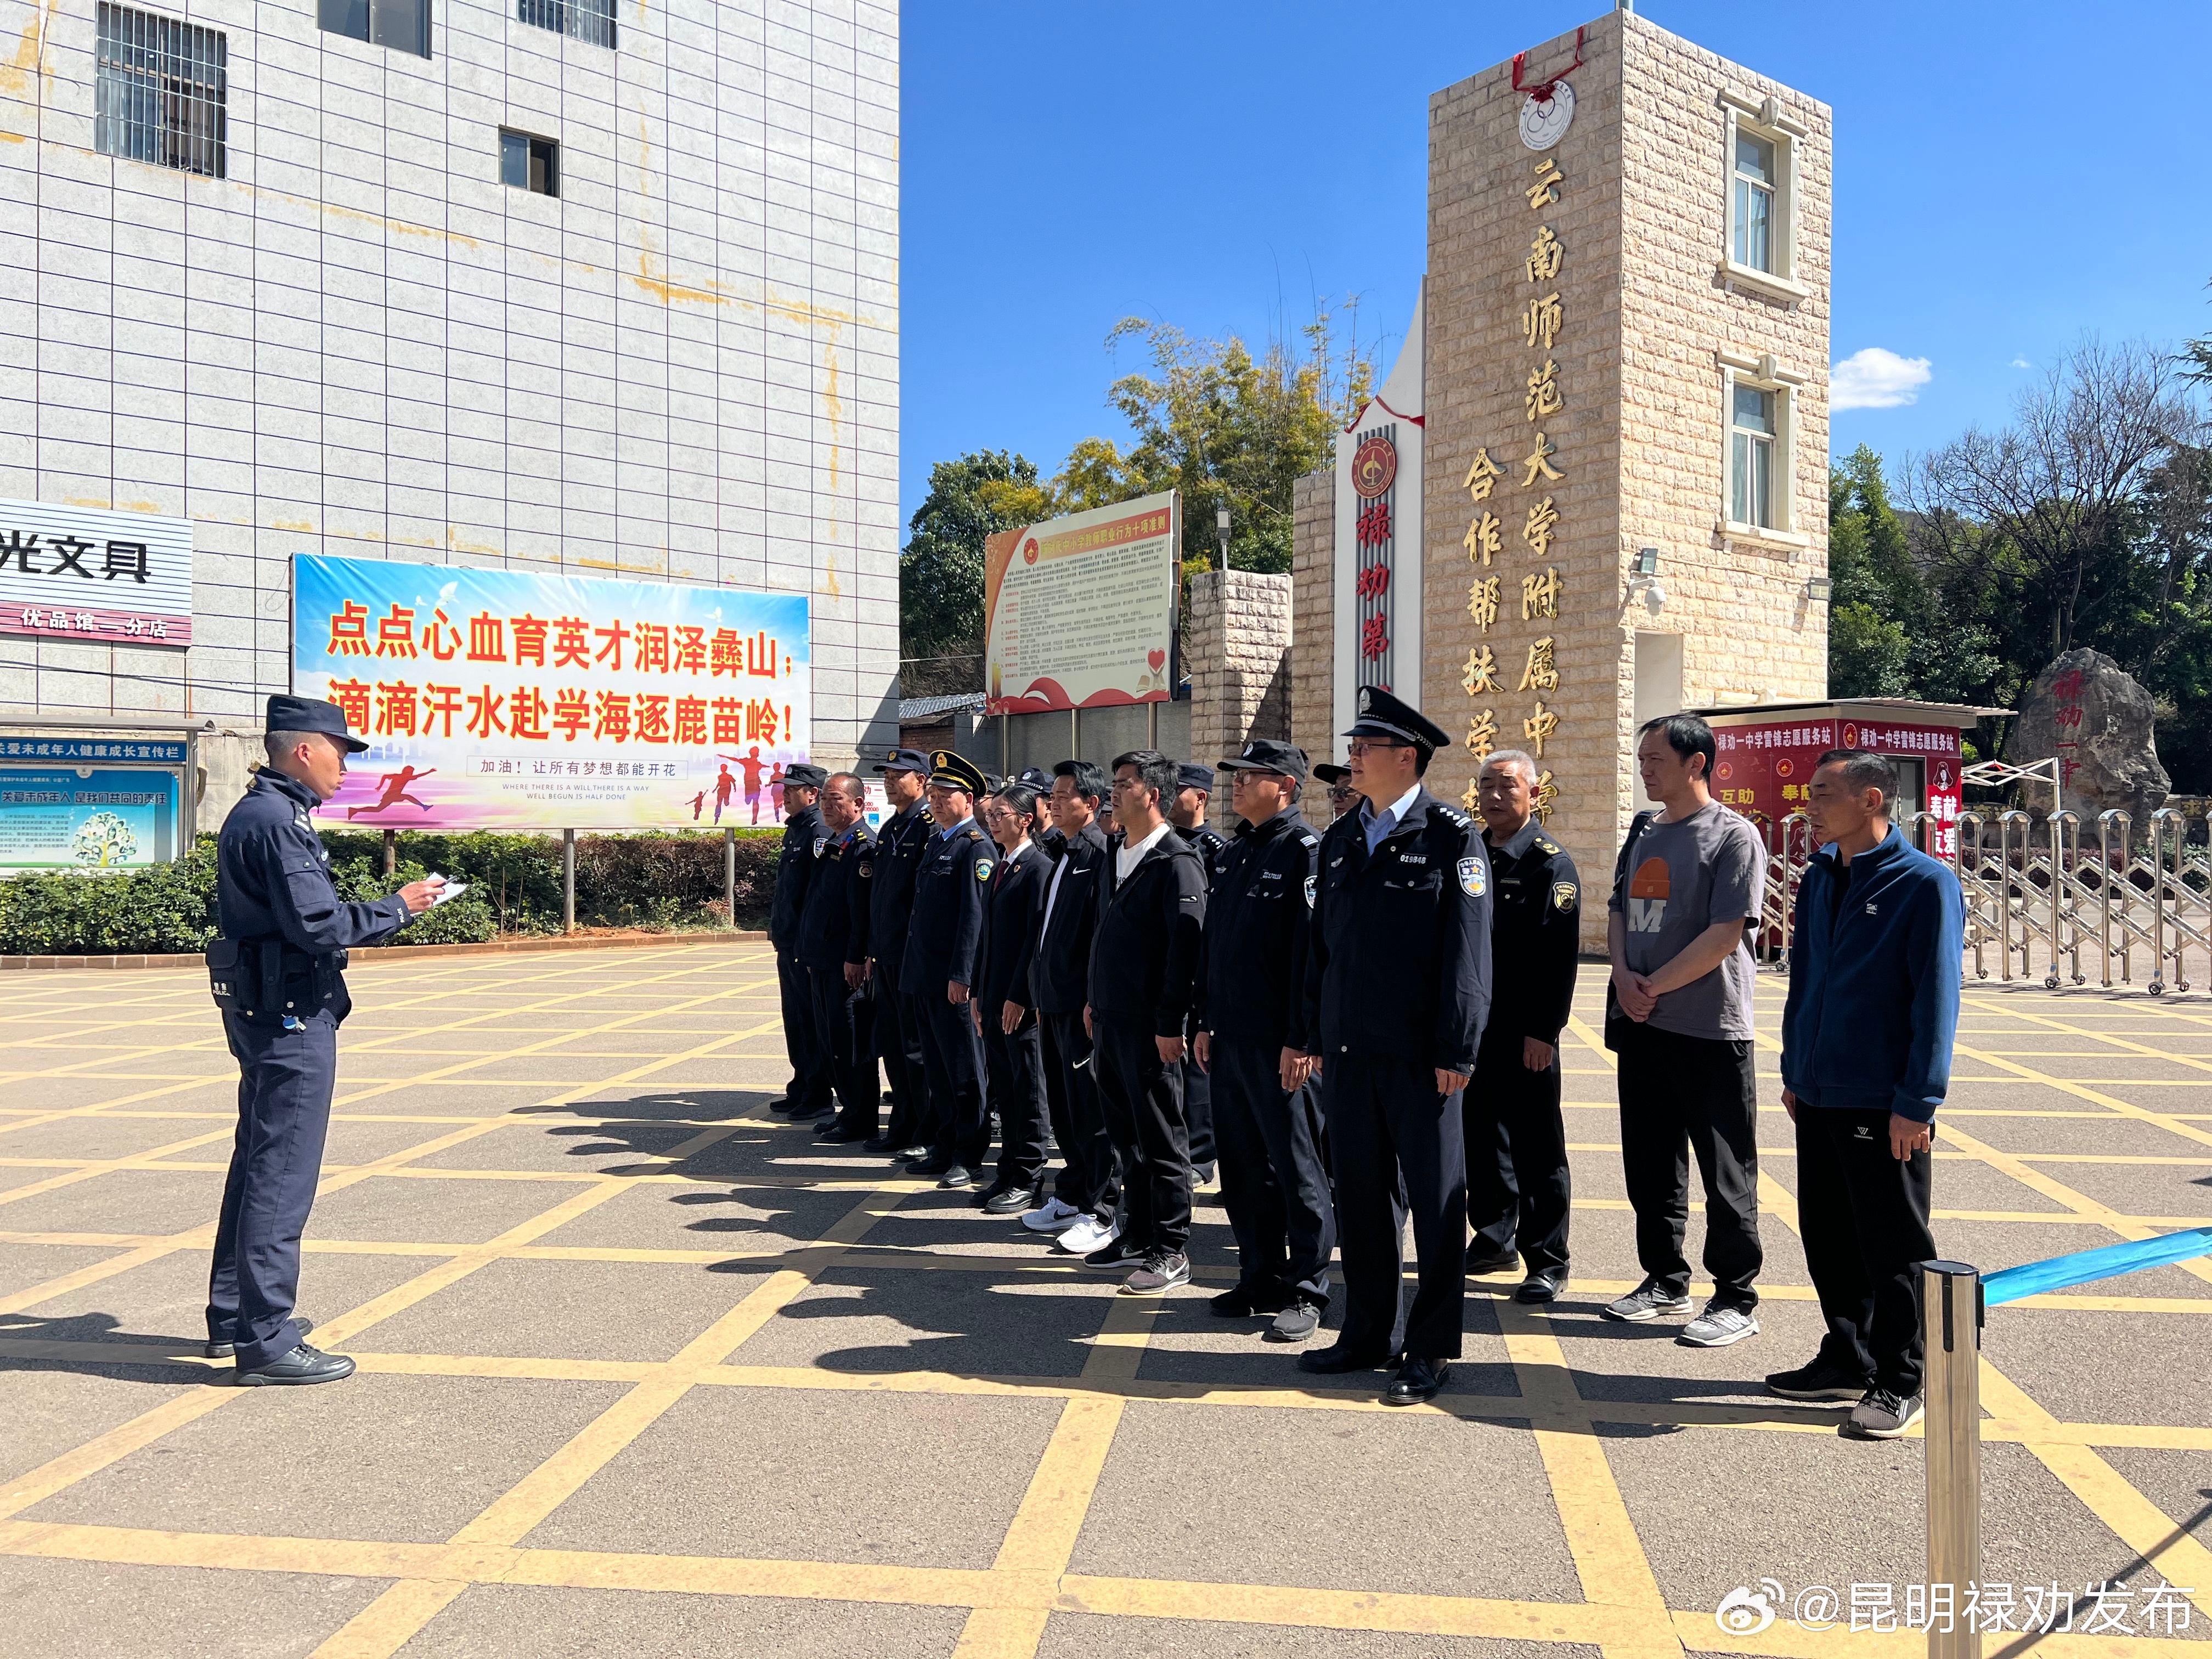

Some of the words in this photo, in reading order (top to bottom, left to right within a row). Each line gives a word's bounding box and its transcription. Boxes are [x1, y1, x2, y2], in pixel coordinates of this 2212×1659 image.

[0, 530, 151, 584] 光文具
[1718, 726, 1831, 751] 禄劝一中学雷锋志愿服务站
[1860, 727, 1954, 752] 禄劝一中学雷锋志愿服务站
[2052, 669, 2086, 791] 禄劝一中
[1720, 788, 1754, 805] 互助
[1930, 795, 1957, 822] 奉献
[1628, 898, 1667, 933] M
